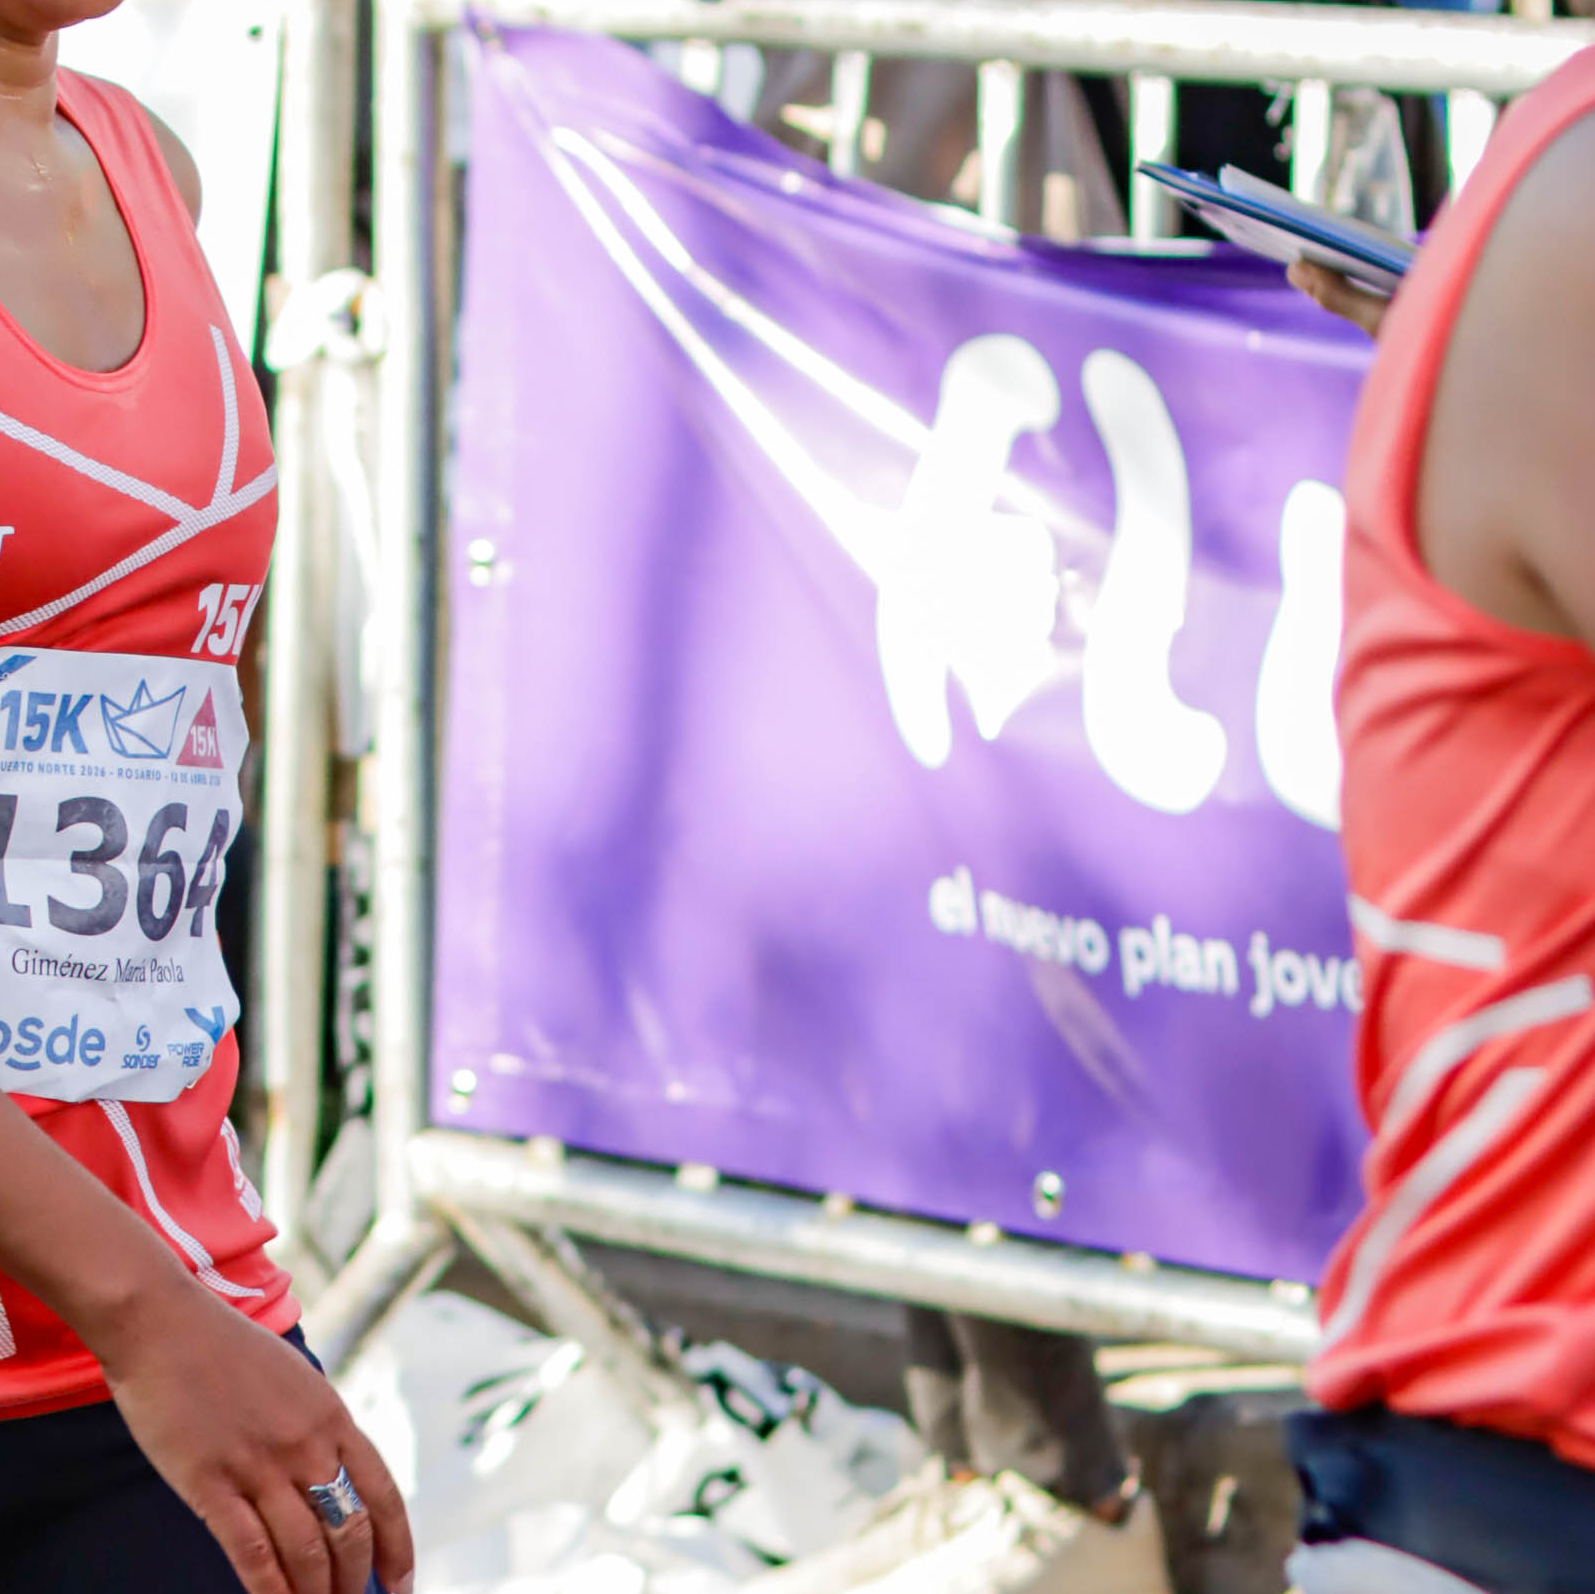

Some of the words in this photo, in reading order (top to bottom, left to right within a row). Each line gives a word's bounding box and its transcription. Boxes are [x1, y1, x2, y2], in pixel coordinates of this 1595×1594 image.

[0, 689, 94, 754] 15K
[37, 762, 76, 775] NORTE
[117, 768, 162, 781] ROSARIO
[979, 889, 1110, 975] nuevo
[1118, 912, 1239, 999] plan
[12, 948, 108, 982] Giménez
[150, 958, 184, 983] Paola
[166, 1042, 205, 1055] POWER
